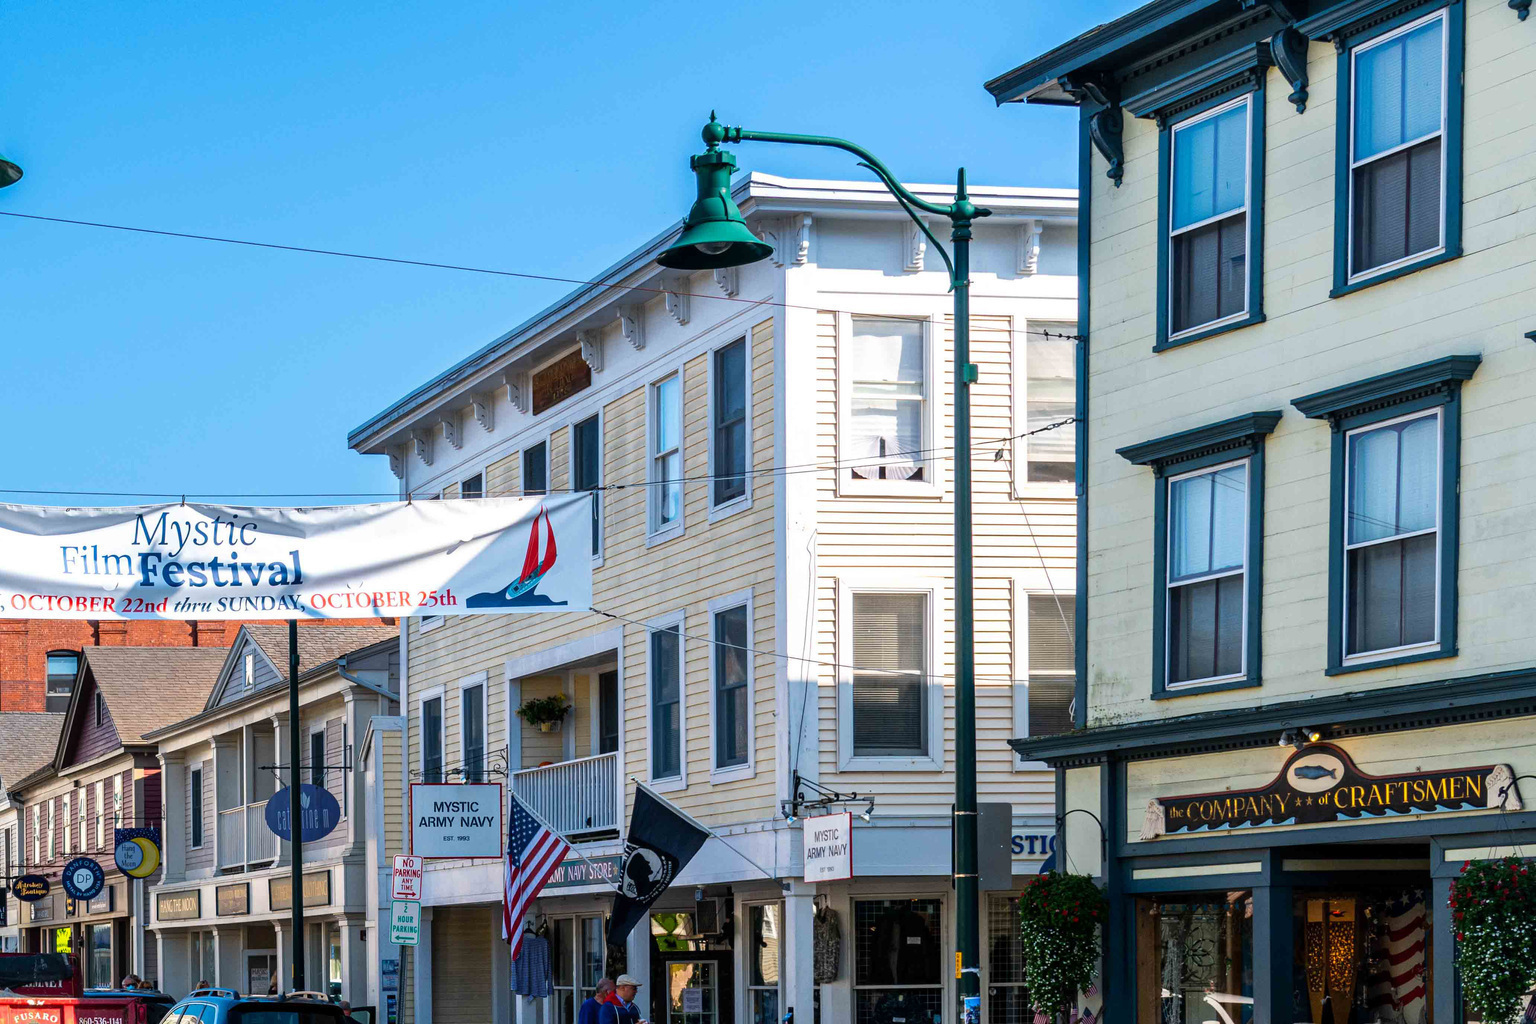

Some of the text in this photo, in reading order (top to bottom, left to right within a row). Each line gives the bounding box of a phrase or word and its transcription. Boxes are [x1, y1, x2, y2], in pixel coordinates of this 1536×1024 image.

[132, 512, 258, 556] Mystic
[60, 545, 303, 588] Film Festival
[10, 593, 116, 613] OCTOBER
[121, 598, 167, 614] 22nd
[173, 598, 212, 613] thru
[217, 594, 306, 613] SUNDAY,
[310, 591, 410, 611] OCTOBER
[418, 588, 458, 608] 25th
[1169, 774, 1482, 821] the COMPANY of CRAFTSMEN
[433, 801, 479, 813] MYSTIC
[277, 808, 319, 830] catrine
[419, 816, 495, 828] ARMY NAVY
[814, 828, 839, 843] MYSTIC
[121, 844, 136, 853] Hang
[807, 844, 847, 860] ARMY NAVY
[402, 859, 414, 868] NO
[395, 868, 421, 878] PARKING
[568, 865, 587, 881] NAVY
[589, 862, 612, 879] STORE
[76, 874, 92, 884] DP
[397, 915, 413, 923] HOUR
[393, 925, 417, 933] PARKING
[14, 1011, 58, 1024] FUSARO
